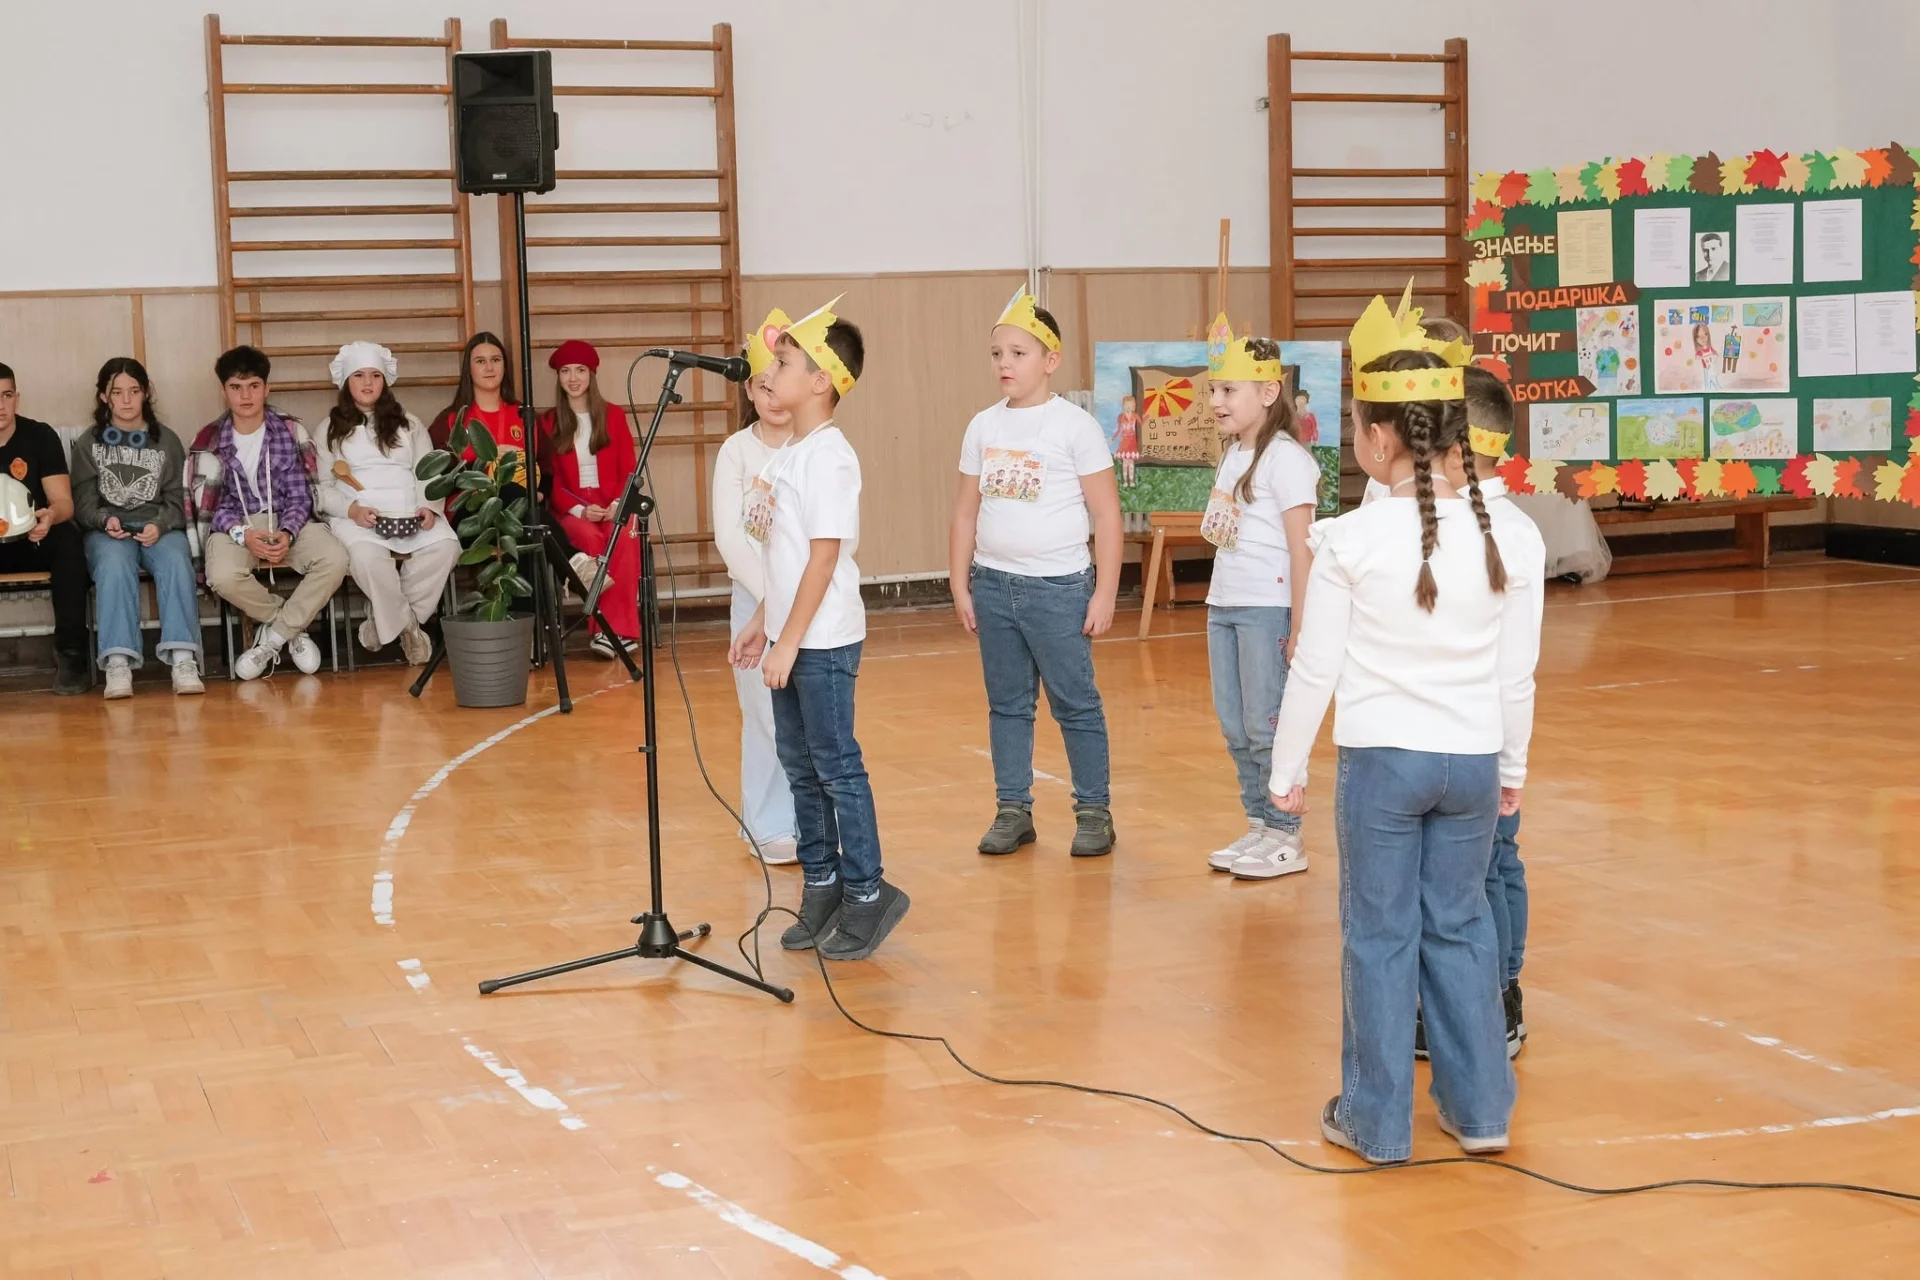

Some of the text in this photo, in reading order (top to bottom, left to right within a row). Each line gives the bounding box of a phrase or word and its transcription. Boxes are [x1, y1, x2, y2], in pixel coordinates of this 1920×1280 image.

[1474, 235, 1555, 258] ЗНАЕЊЕ
[1506, 285, 1627, 310] ПОДДРШКА
[1492, 333, 1560, 353] ПОЧИТ
